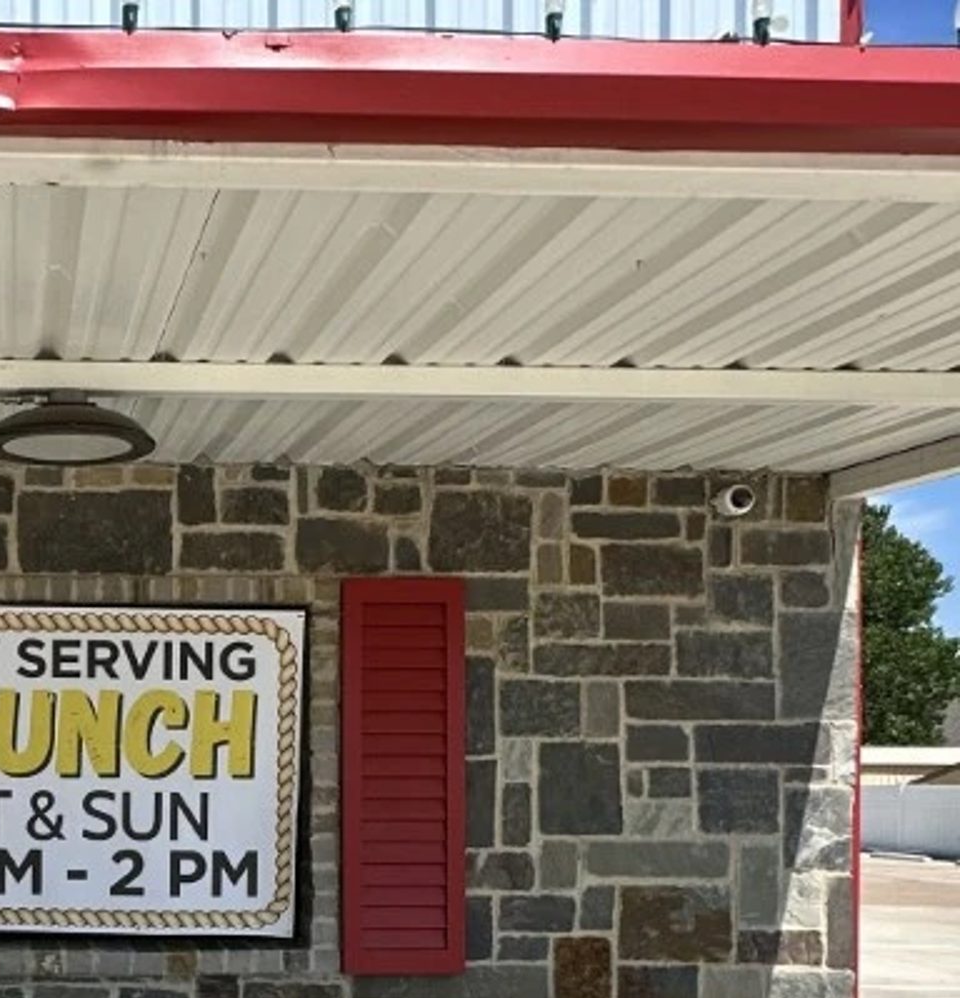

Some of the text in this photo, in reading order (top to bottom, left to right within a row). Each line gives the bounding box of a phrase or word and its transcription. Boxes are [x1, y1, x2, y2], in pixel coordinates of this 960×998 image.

[17, 638, 257, 681] SERVING
[26, 790, 66, 841] &
[82, 791, 209, 841] SUN
[66, 867, 88, 881] -
[109, 849, 145, 897] 2
[169, 850, 259, 898] PM
